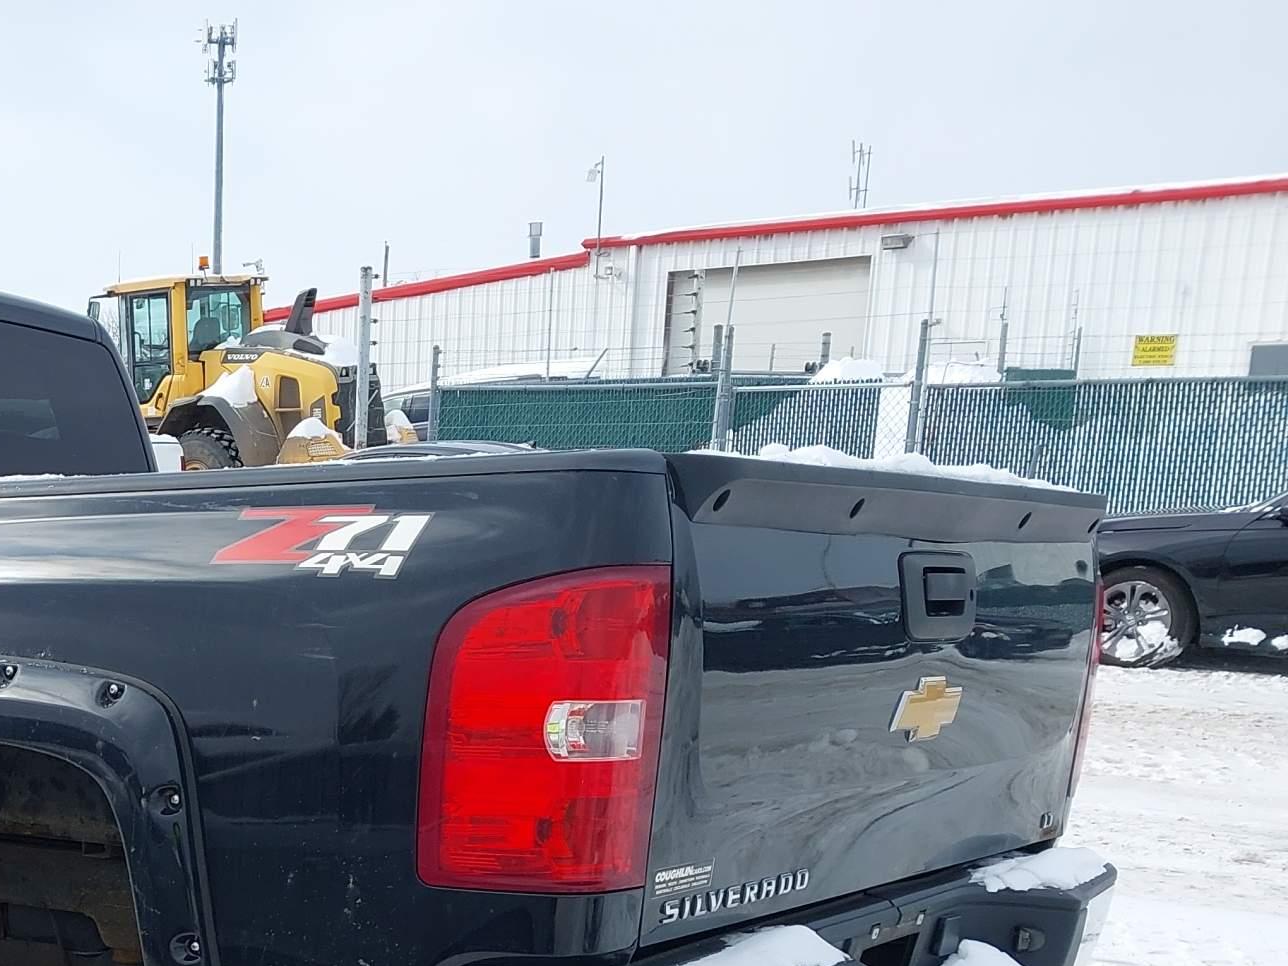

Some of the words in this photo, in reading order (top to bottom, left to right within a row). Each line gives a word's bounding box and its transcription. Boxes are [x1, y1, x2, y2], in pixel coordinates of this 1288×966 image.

[1137, 335, 1175, 344] WARNING
[227, 353, 258, 361] VOLVO
[209, 504, 435, 564] Z71
[661, 868, 810, 924] SILVERADO
